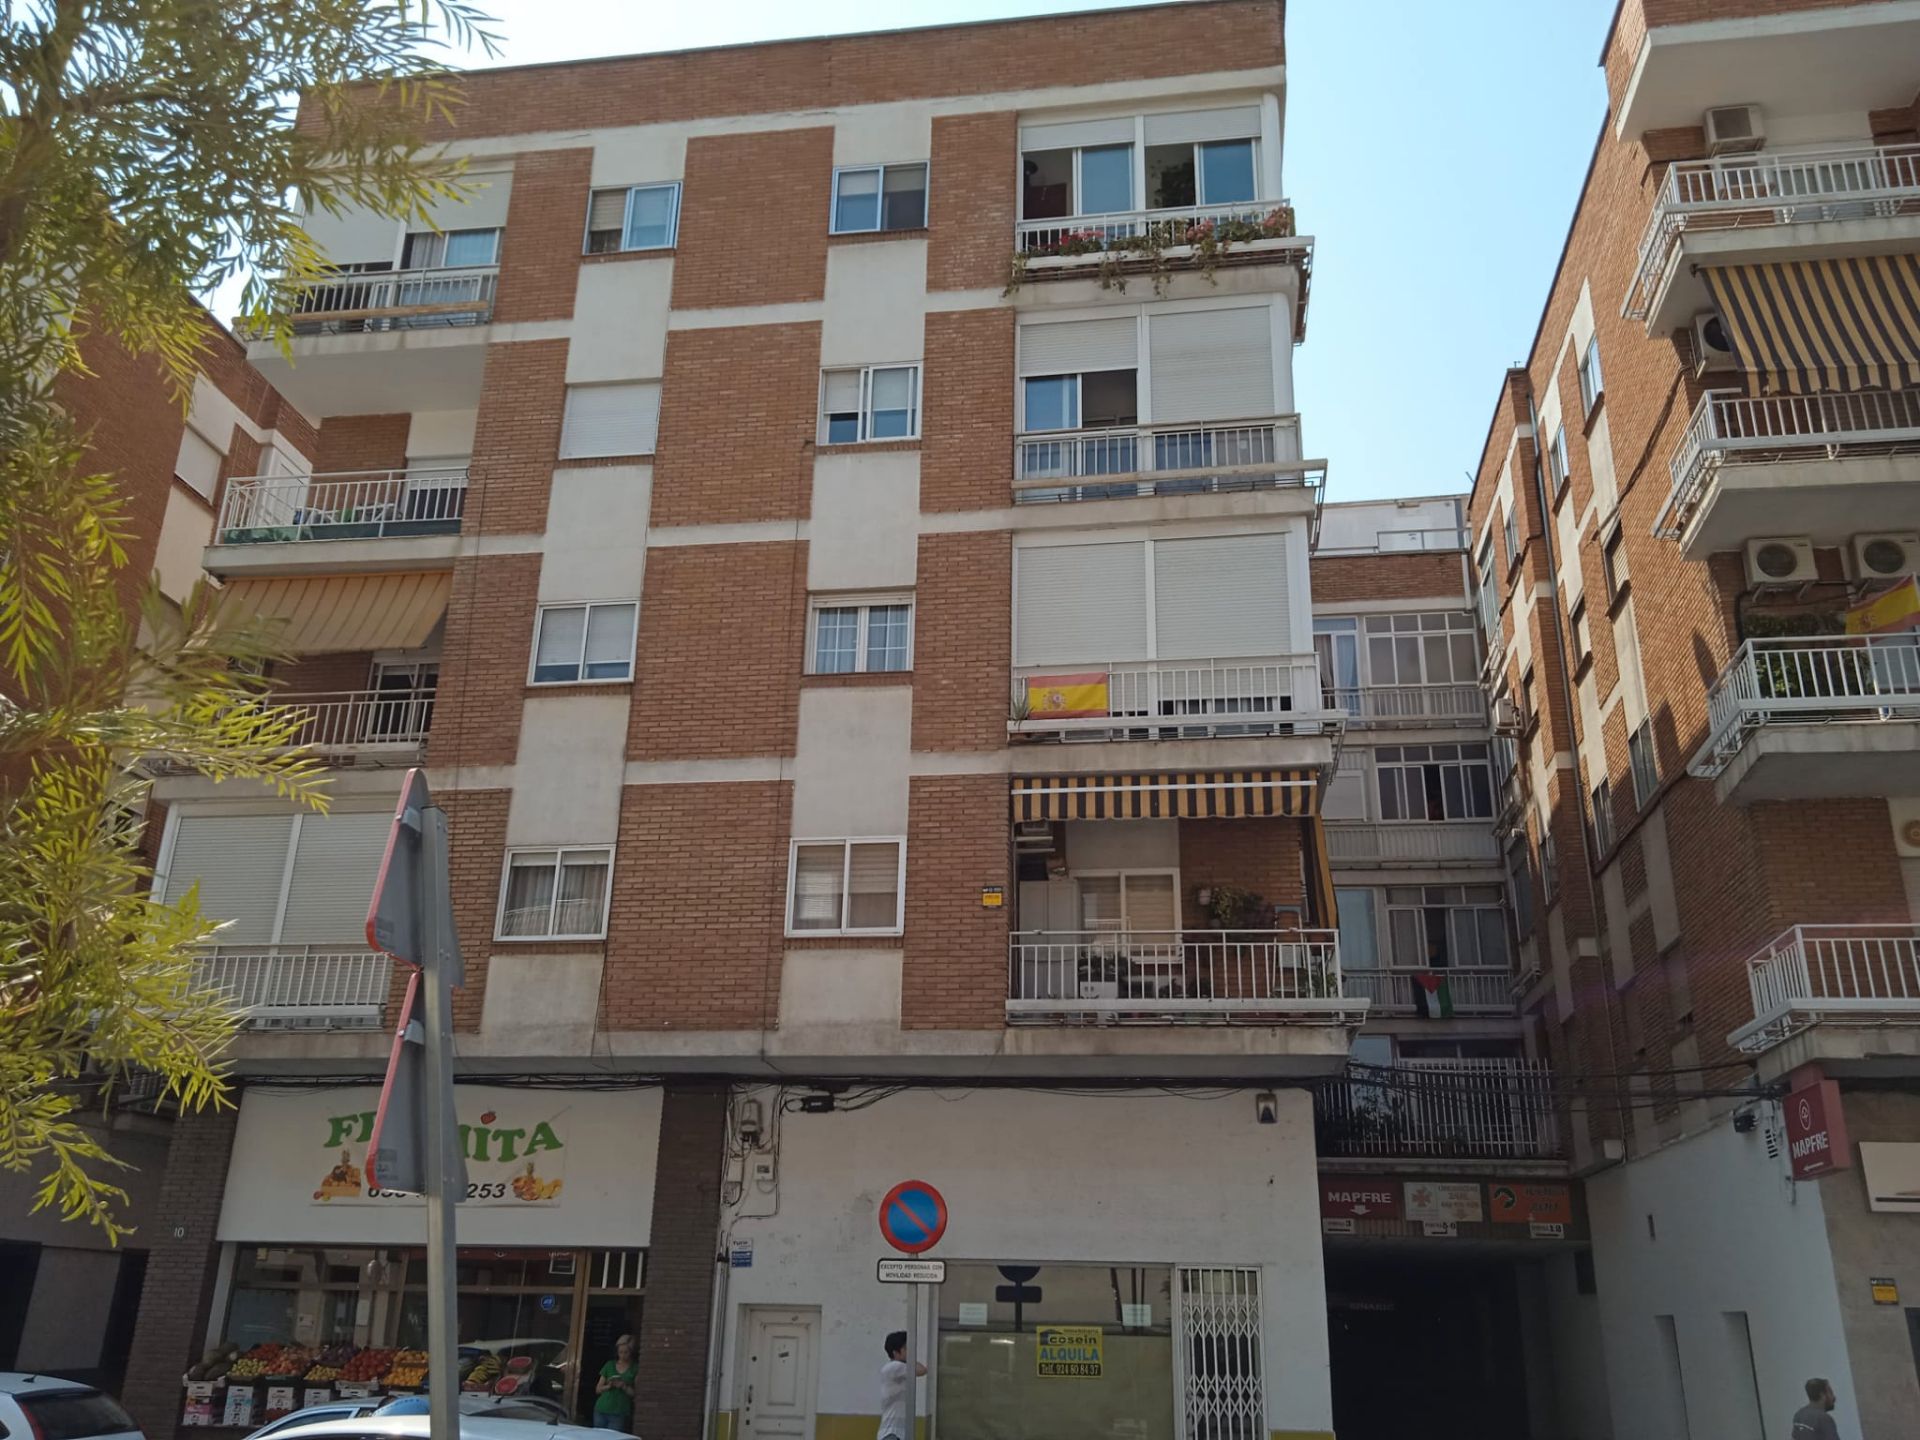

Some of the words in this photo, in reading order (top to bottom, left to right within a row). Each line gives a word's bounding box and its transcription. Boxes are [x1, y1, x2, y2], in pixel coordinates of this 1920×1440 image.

[1791, 1131, 1830, 1160] MAPFRE
[466, 1183, 506, 1199] 253
[1327, 1191, 1393, 1204] MAPFRE
[174, 1226, 185, 1239] 10
[1049, 1334, 1097, 1344] cosein
[1040, 1347, 1099, 1361] ALQUILA
